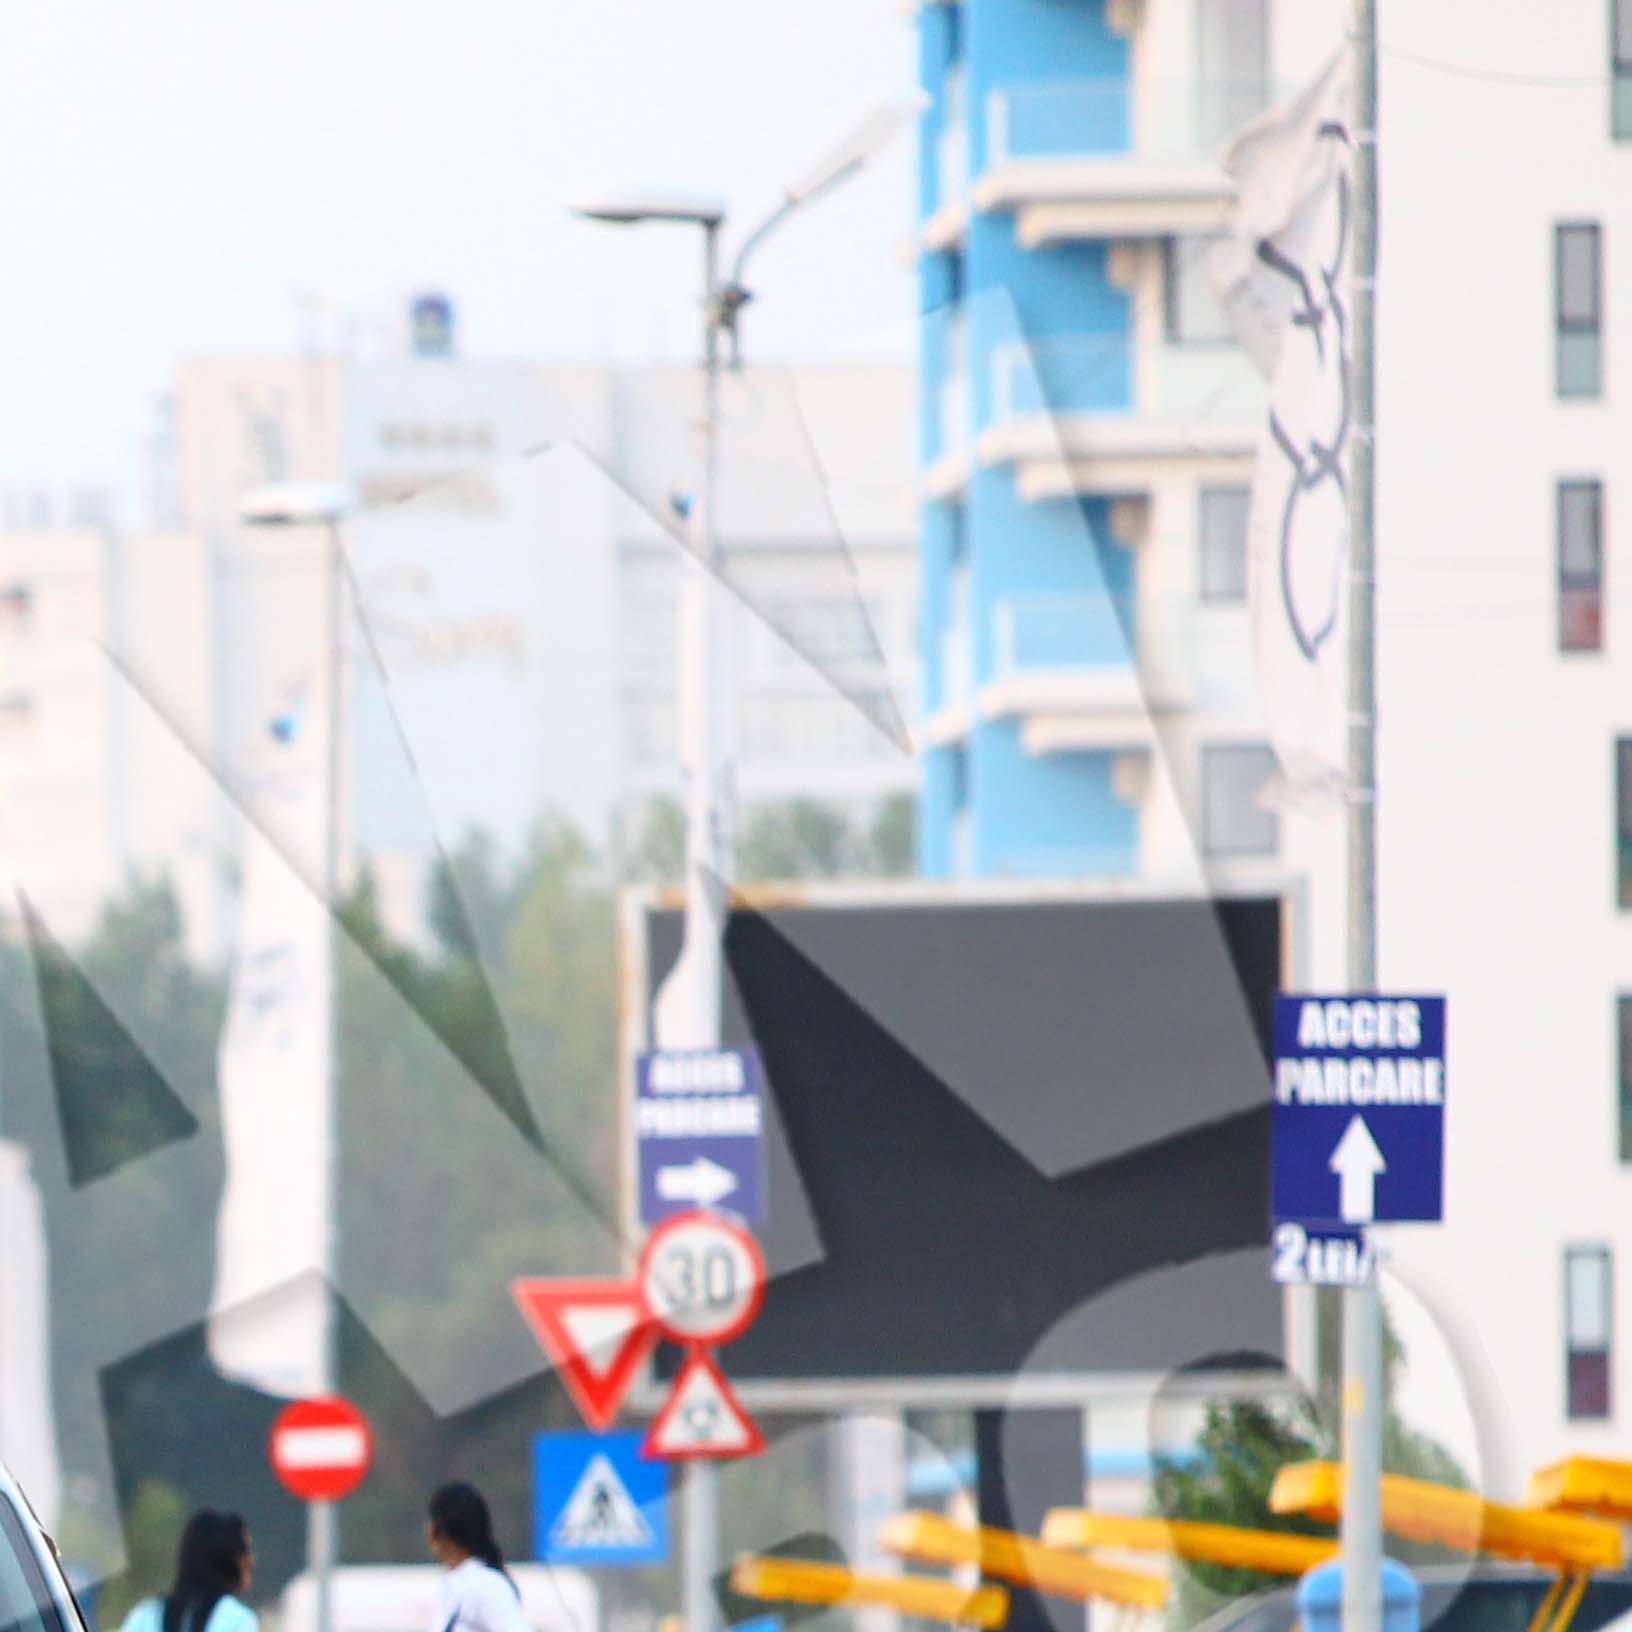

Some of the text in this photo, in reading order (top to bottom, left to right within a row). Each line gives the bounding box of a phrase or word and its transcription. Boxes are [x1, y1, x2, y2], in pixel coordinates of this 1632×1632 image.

[1296, 1000, 1423, 1050] ACCES
[1275, 1056, 1444, 1106] PARCARE
[658, 1246, 737, 1312] 30
